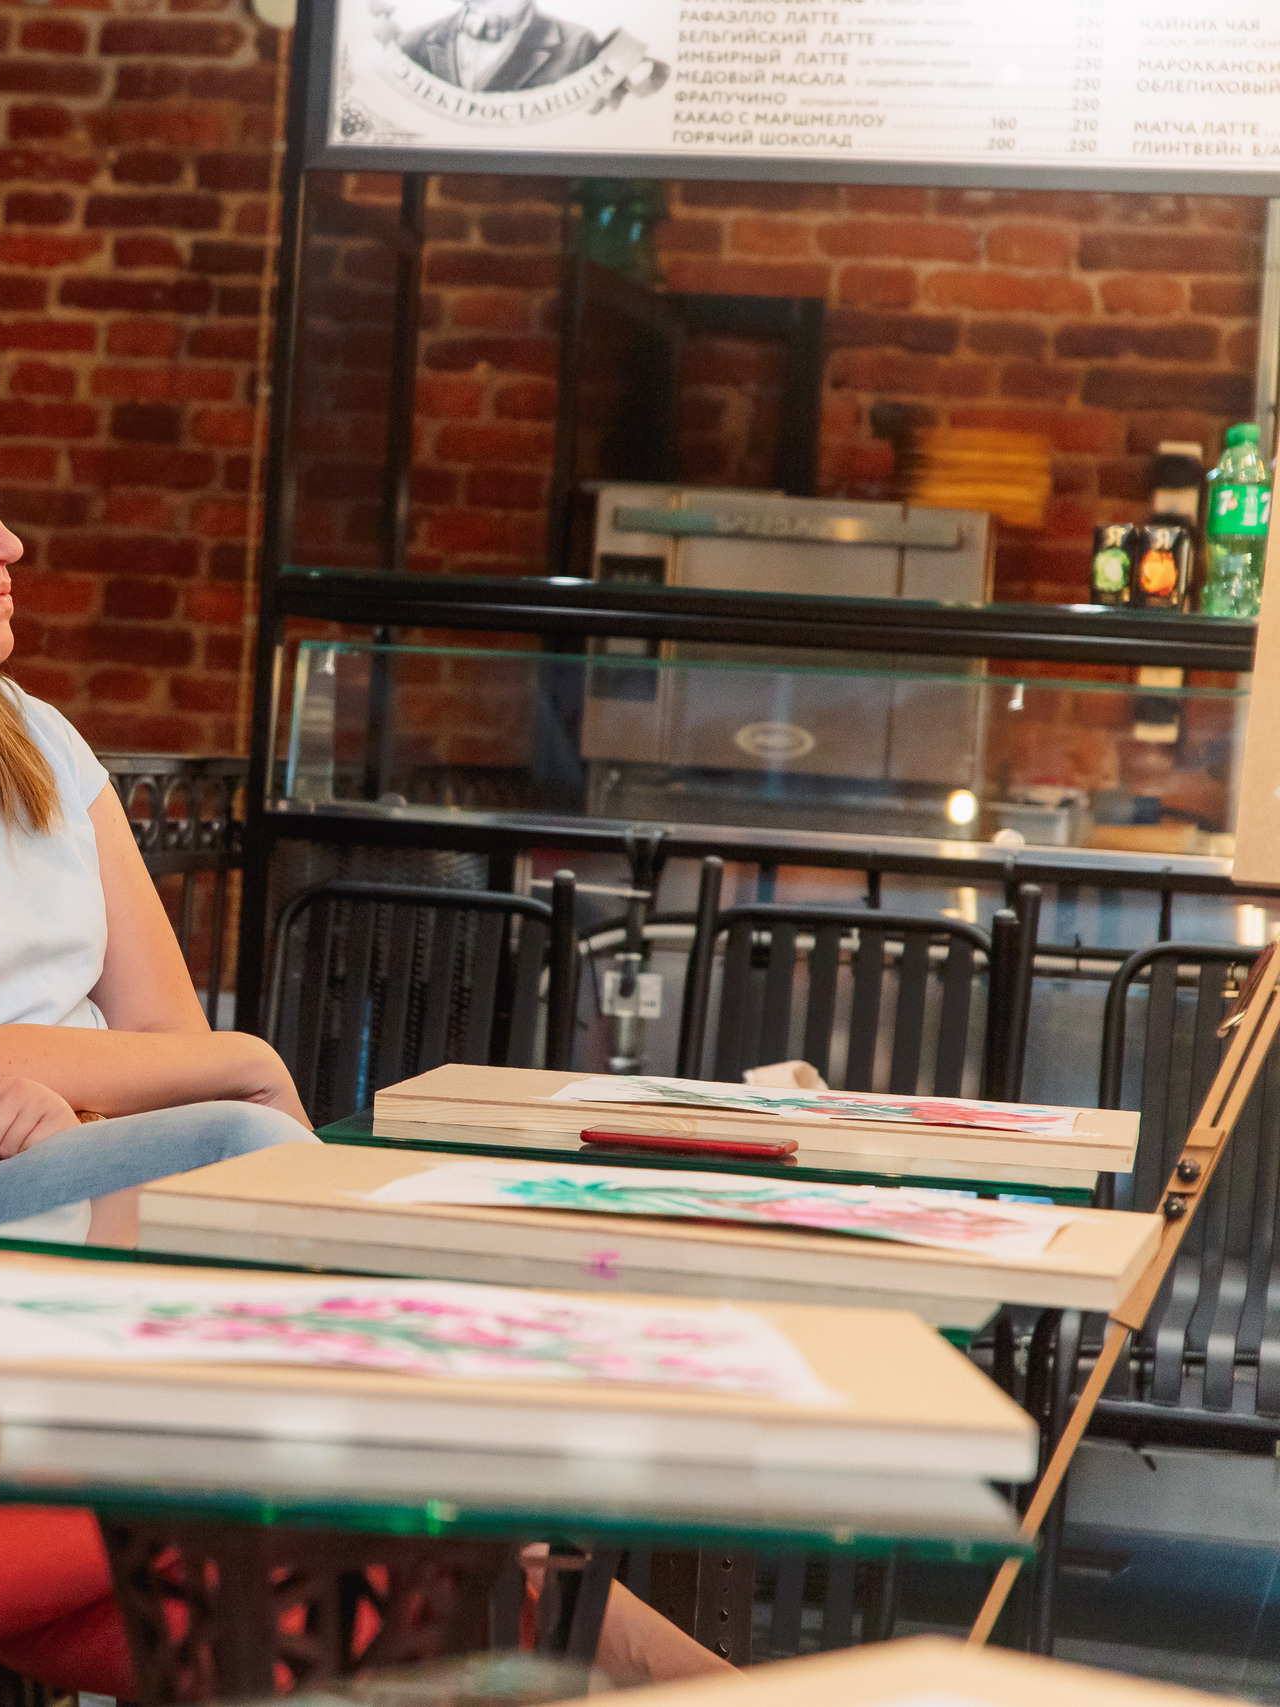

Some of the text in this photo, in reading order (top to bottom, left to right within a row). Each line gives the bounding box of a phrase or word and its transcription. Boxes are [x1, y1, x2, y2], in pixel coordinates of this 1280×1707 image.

[680, 10, 776, 24] РАФАЭЛЛО
[784, 11, 840, 25] ЛАТТЕ
[1140, 16, 1261, 32] ЧАЙНИК ЧАЯ
[678, 29, 807, 44] БЕЛЬГИЙСКИЙ
[820, 32, 876, 46] ЛАТТЕ
[677, 48, 781, 64] ИМБИРНЫЙ
[794, 52, 849, 66] ЛАТТЕ
[1073, 56, 1102, 70] 250
[676, 69, 765, 84] МЕДОВЫЙ
[772, 72, 846, 86] МАСАЛА
[1072, 77, 1100, 91] 250
[395, 61, 615, 121] ЭЛЕКТРОСТАНЦИЯ
[674, 91, 786, 106] ФРАПУЧИНО
[1072, 98, 1100, 111] 250
[673, 110, 1099, 132] КАКАО С МАРШМЕЛЛОУ 160 210
[1133, 119, 1260, 136] МАТЧА ЛАТТЕ
[672, 129, 1097, 152] ГОРЯЧИЙ ШОКОЛАД 200 250
[1133, 139, 1242, 156] ГЛИНТВЕЙН
